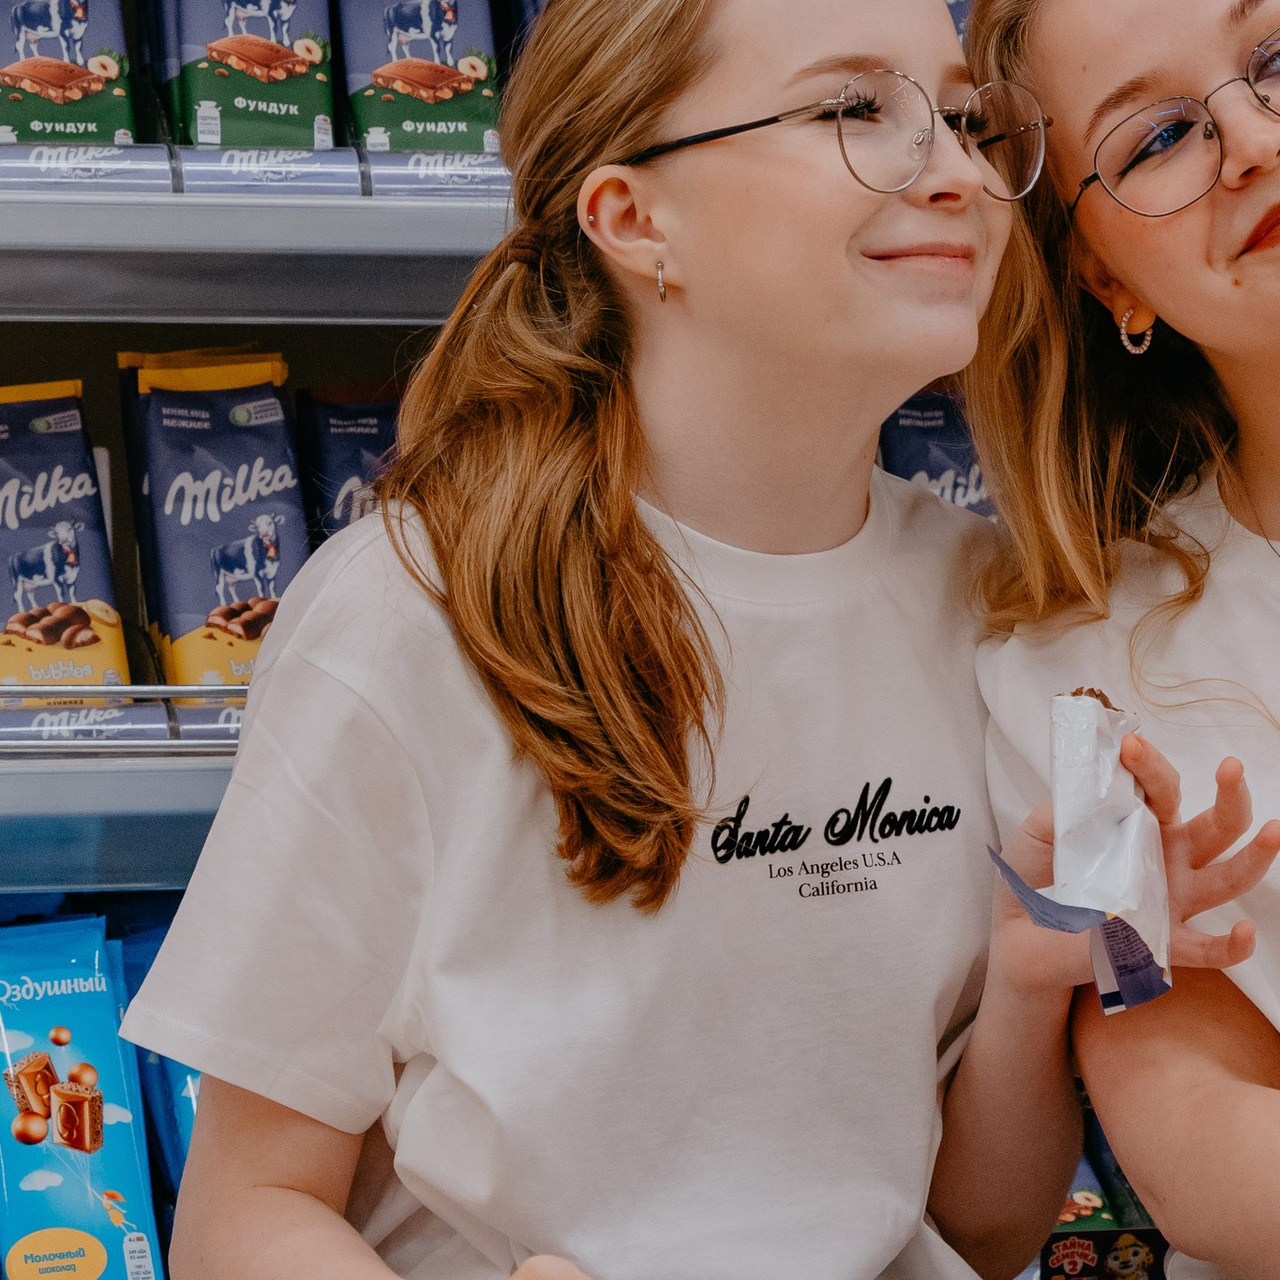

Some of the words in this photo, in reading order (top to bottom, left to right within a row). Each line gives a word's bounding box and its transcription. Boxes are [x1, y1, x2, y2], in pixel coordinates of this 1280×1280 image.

[234, 96, 299, 115] Фундук
[30, 120, 98, 133] Фундук
[402, 120, 467, 133] Фундук
[165, 457, 296, 525] Milka
[29, 658, 93, 681] bubbles
[31, 707, 123, 739] Milka
[711, 795, 812, 864] Santa
[824, 777, 961, 846] Monica
[769, 863, 794, 879] Los
[798, 857, 859, 878] Angeles
[862, 851, 902, 868] U.S.A
[799, 877, 878, 899] California
[0, 974, 107, 1005] оздушный
[24, 1247, 86, 1264] Молочный
[1054, 1239, 1093, 1253] ТАЙНА
[38, 1263, 76, 1275] шоколад
[1068, 1261, 1077, 1272] 2
